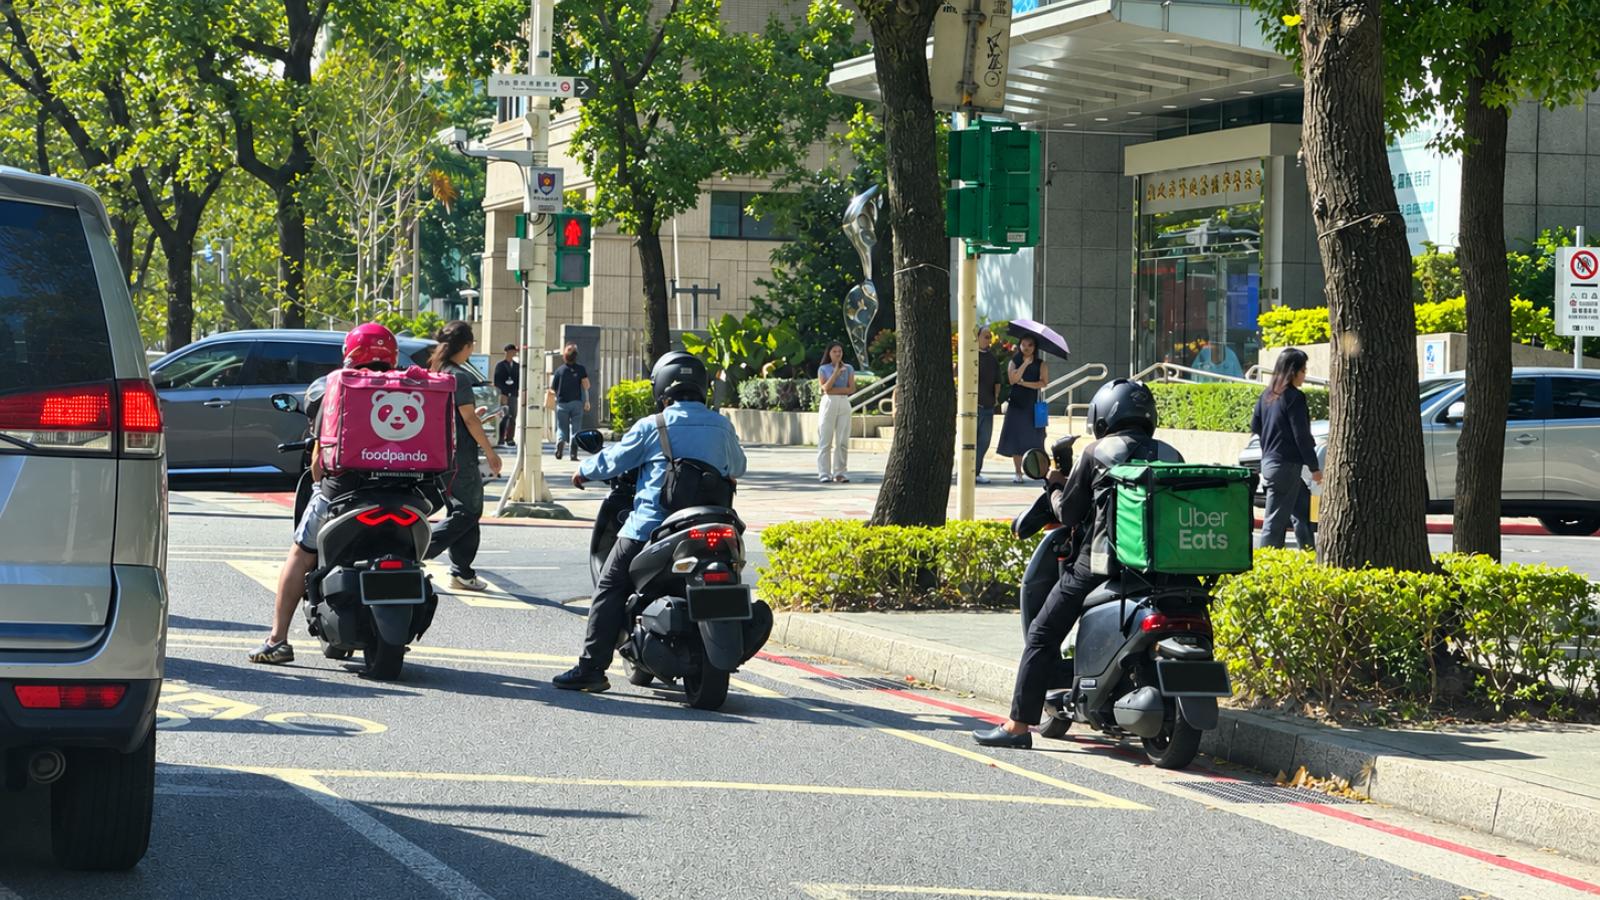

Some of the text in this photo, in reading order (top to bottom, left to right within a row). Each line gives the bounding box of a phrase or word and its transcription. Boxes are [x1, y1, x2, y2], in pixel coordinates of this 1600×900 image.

[361, 448, 428, 464] foodpanda
[1178, 506, 1229, 528] Uber
[1179, 529, 1229, 550] Eats
